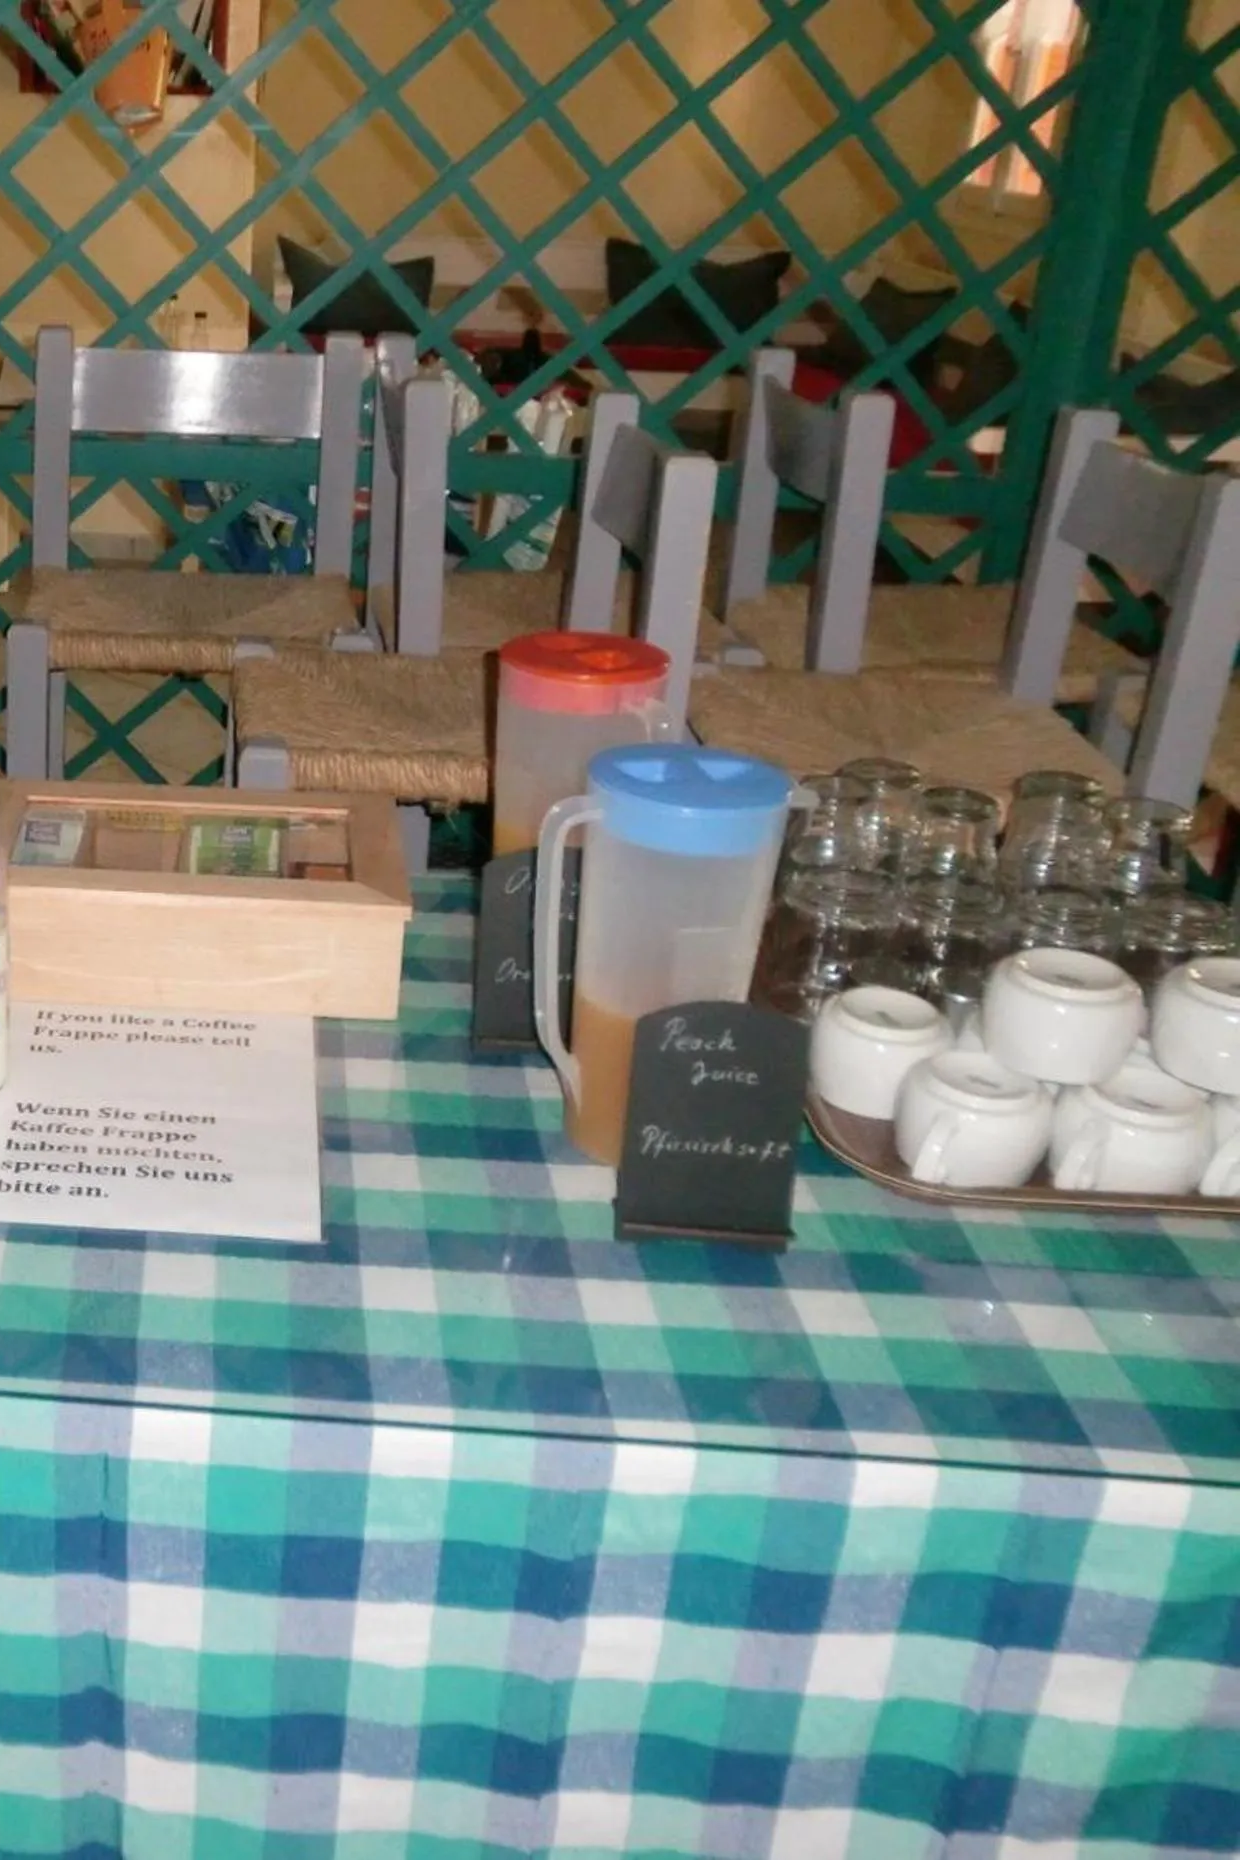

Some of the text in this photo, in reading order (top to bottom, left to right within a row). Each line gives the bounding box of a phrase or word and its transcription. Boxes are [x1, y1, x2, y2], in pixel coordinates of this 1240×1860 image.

[59, 1012, 103, 1024] you
[111, 1013, 156, 1026] like
[161, 1018, 175, 1028] a
[182, 1018, 257, 1032] Coffee
[33, 1025, 251, 1048] Frappe please tell
[660, 1016, 737, 1052] Peach
[29, 1045, 63, 1054] us.
[690, 1059, 760, 1086] Juice
[16, 1102, 217, 1125] Wenn Sie einen
[10, 1120, 197, 1144] Kaffee Frappe
[5, 1138, 88, 1155] haben
[0, 1158, 235, 1184] sprechen Sie uns
[68, 1185, 110, 1199] an.
